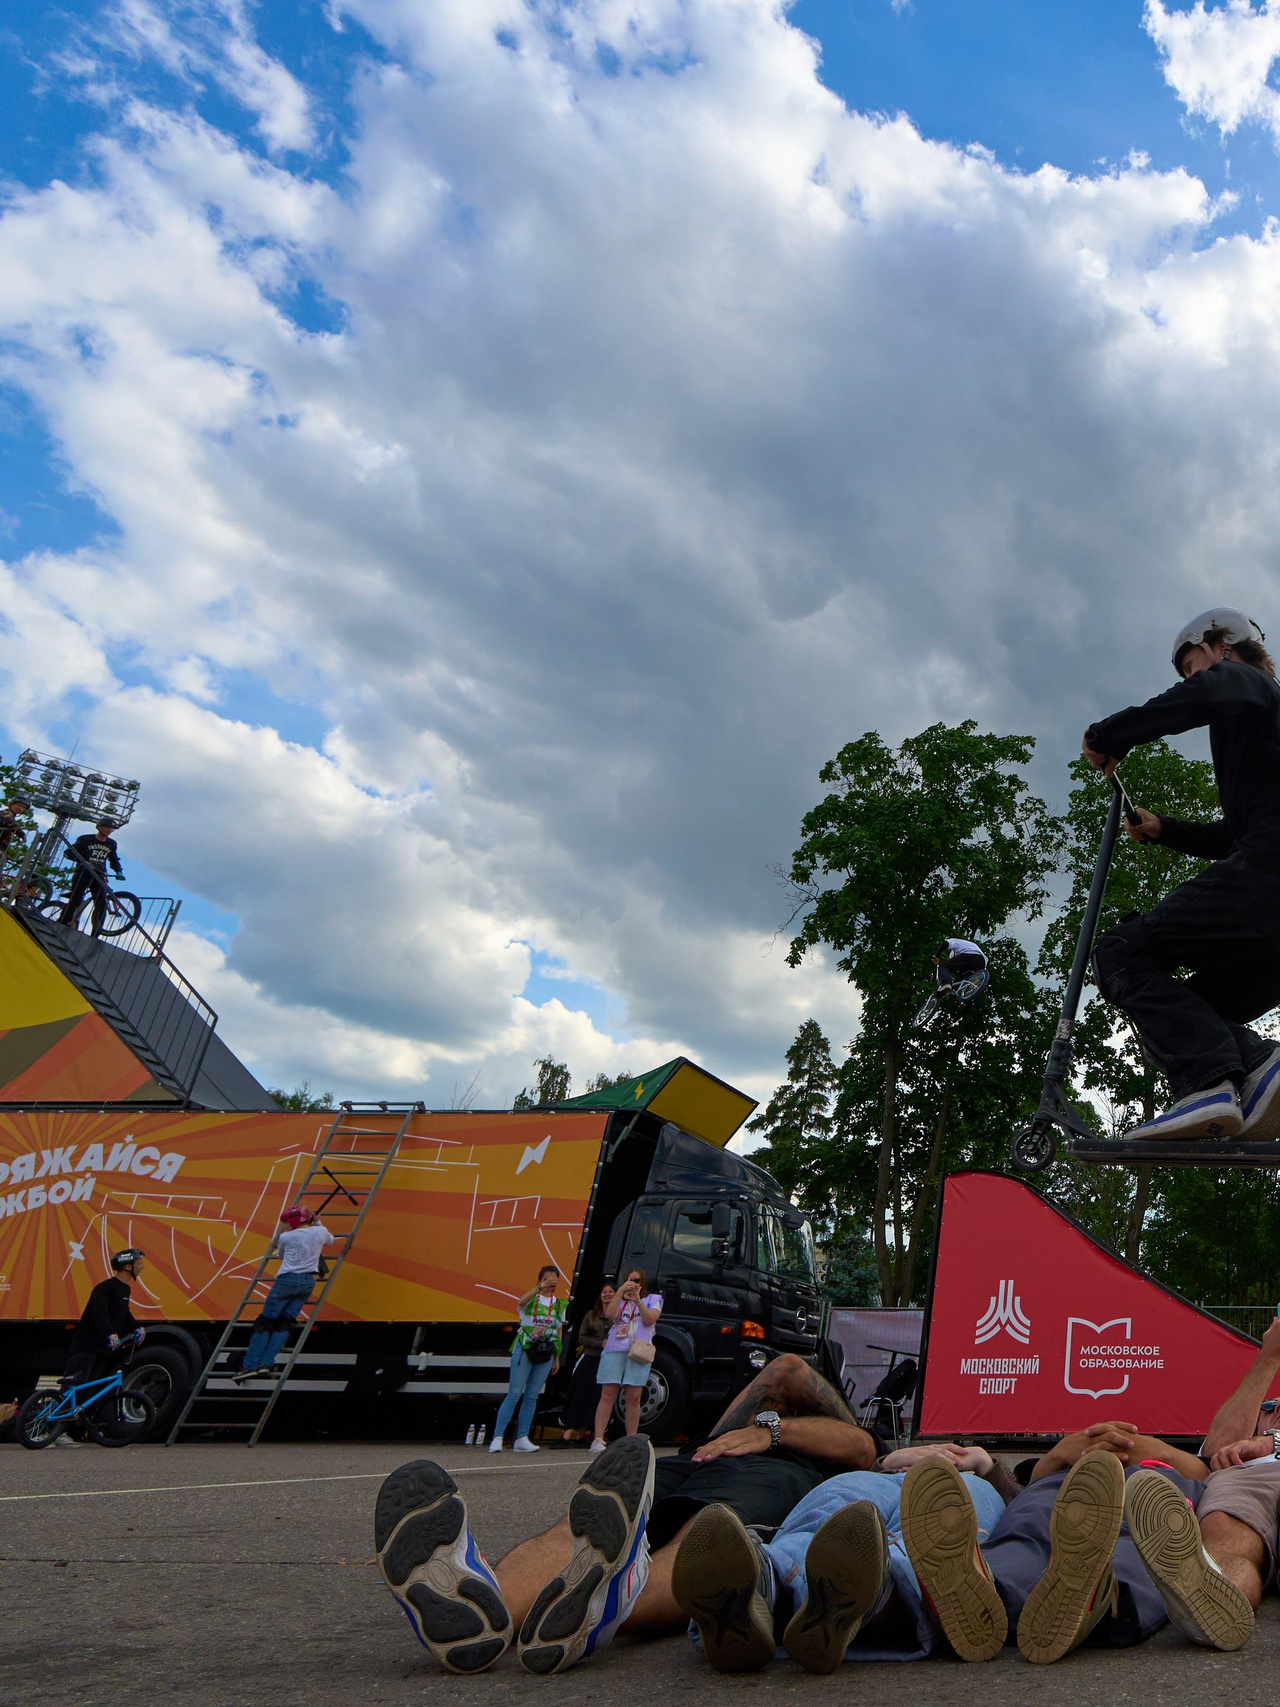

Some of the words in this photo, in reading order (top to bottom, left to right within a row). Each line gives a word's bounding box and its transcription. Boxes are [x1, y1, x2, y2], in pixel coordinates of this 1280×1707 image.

[1080, 1345, 1160, 1356] МОСКОВСКОЕ
[960, 1354, 1040, 1375] МОСКОВСКИЙ
[1079, 1358, 1165, 1369] ОБРАЗОВАНИЕ
[979, 1378, 1017, 1394] СПОРТ
